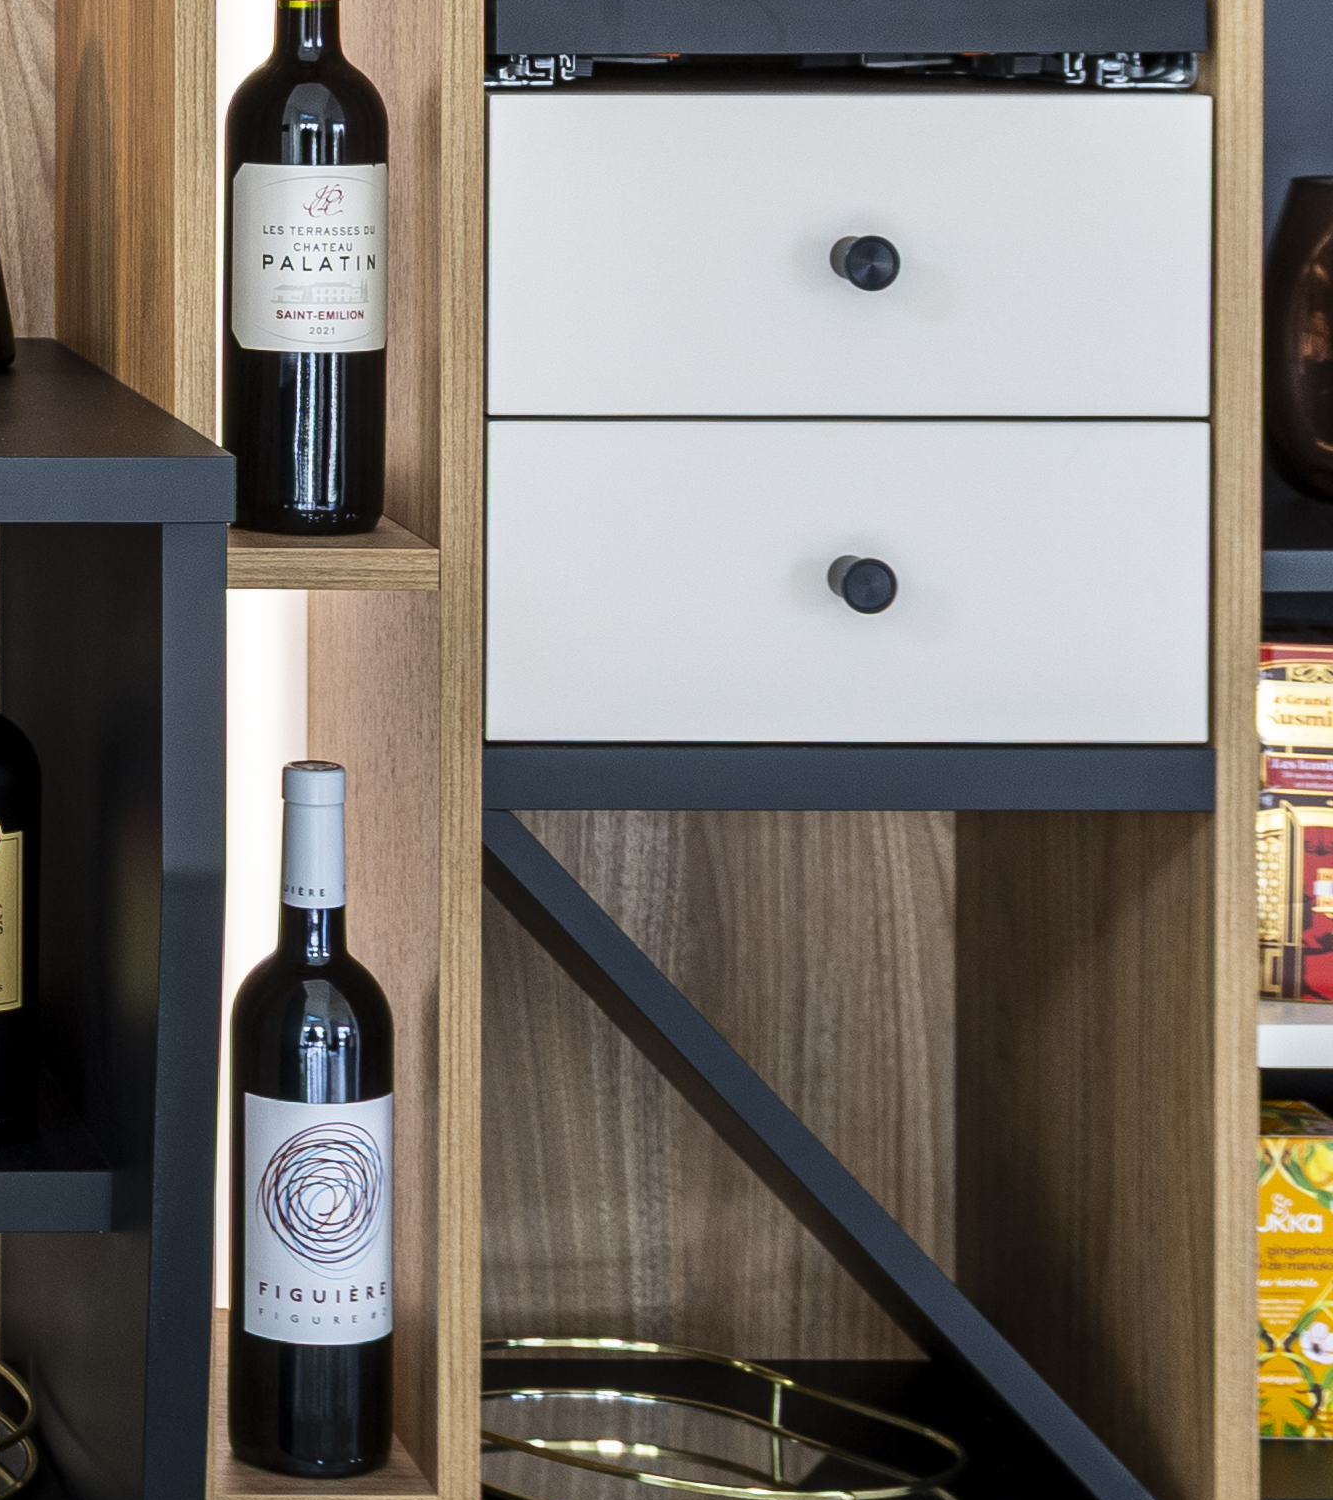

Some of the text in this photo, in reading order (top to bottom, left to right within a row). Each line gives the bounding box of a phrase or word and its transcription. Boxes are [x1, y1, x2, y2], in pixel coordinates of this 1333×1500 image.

[263, 225, 376, 237] LES TERRASSES DU
[293, 242, 354, 253] CHATEAU
[262, 253, 377, 272] PALATIN
[276, 309, 365, 321] SAINT-EMILION
[309, 326, 336, 335] 2021
[259, 1281, 387, 1304] FIGUIÈRE
[258, 1306, 359, 1325] FIGURE
